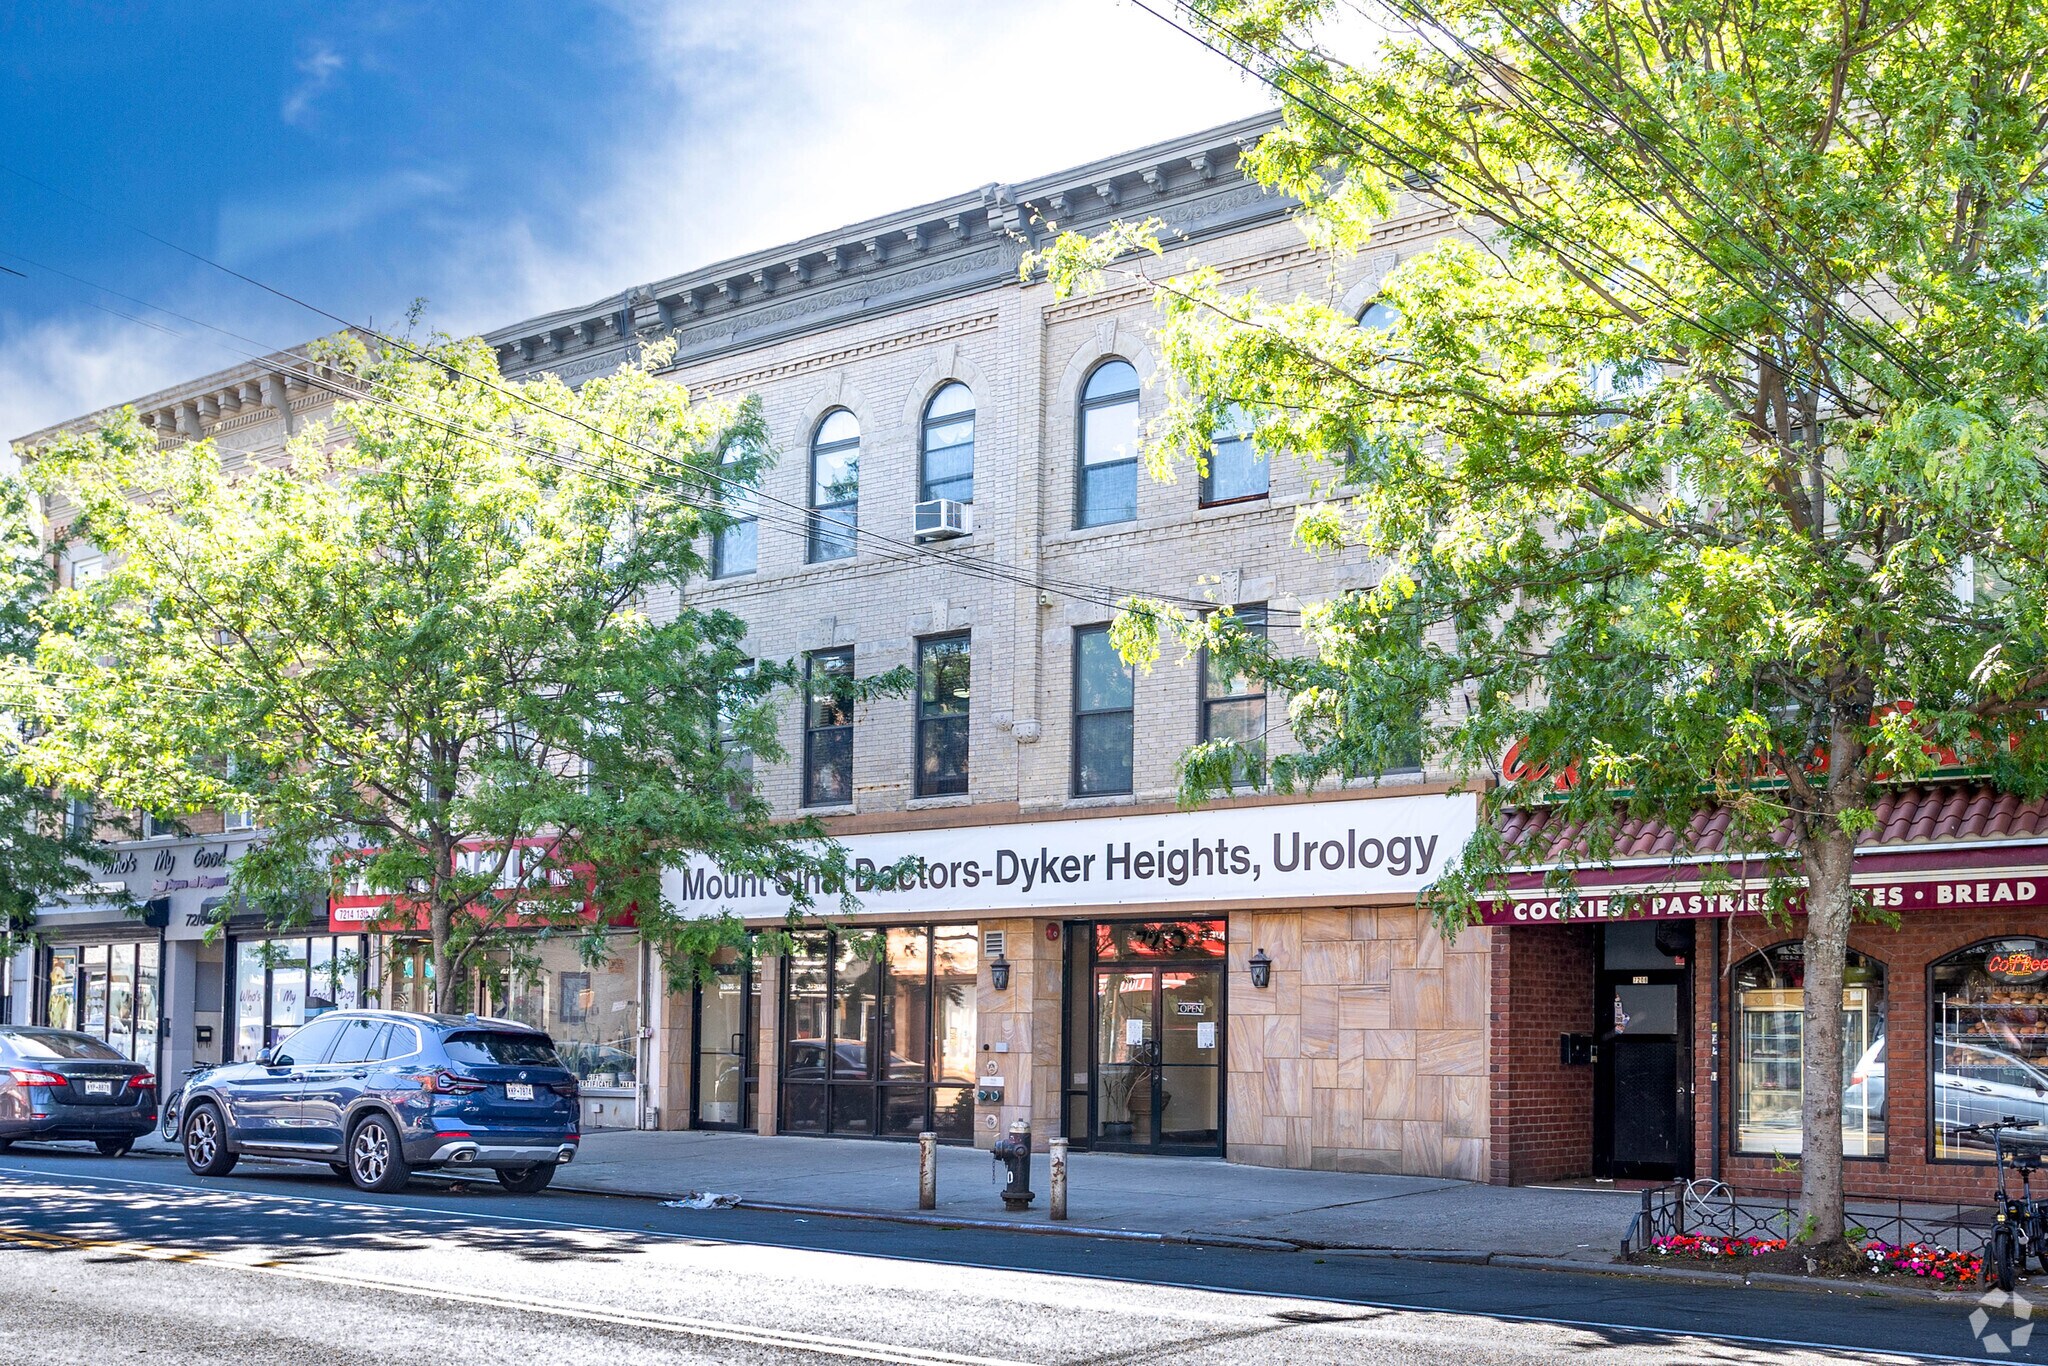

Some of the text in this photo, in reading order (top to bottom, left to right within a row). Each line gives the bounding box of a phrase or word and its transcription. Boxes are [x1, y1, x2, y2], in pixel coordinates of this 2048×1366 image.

[153, 848, 176, 877] My
[194, 843, 228, 869] Good
[682, 829, 1439, 901] Mount Sin Doctors-Dyker Heights, Urology
[1513, 899, 1624, 920] COOKIES
[1652, 893, 1775, 915] PASTRIES
[1937, 881, 2037, 904] BREAD
[1988, 954, 2048, 972] Coffee
[240, 989, 261, 1002] Who's
[283, 989, 296, 1005] My
[340, 988, 355, 1002] Dog
[1179, 1004, 1203, 1013] OPEN
